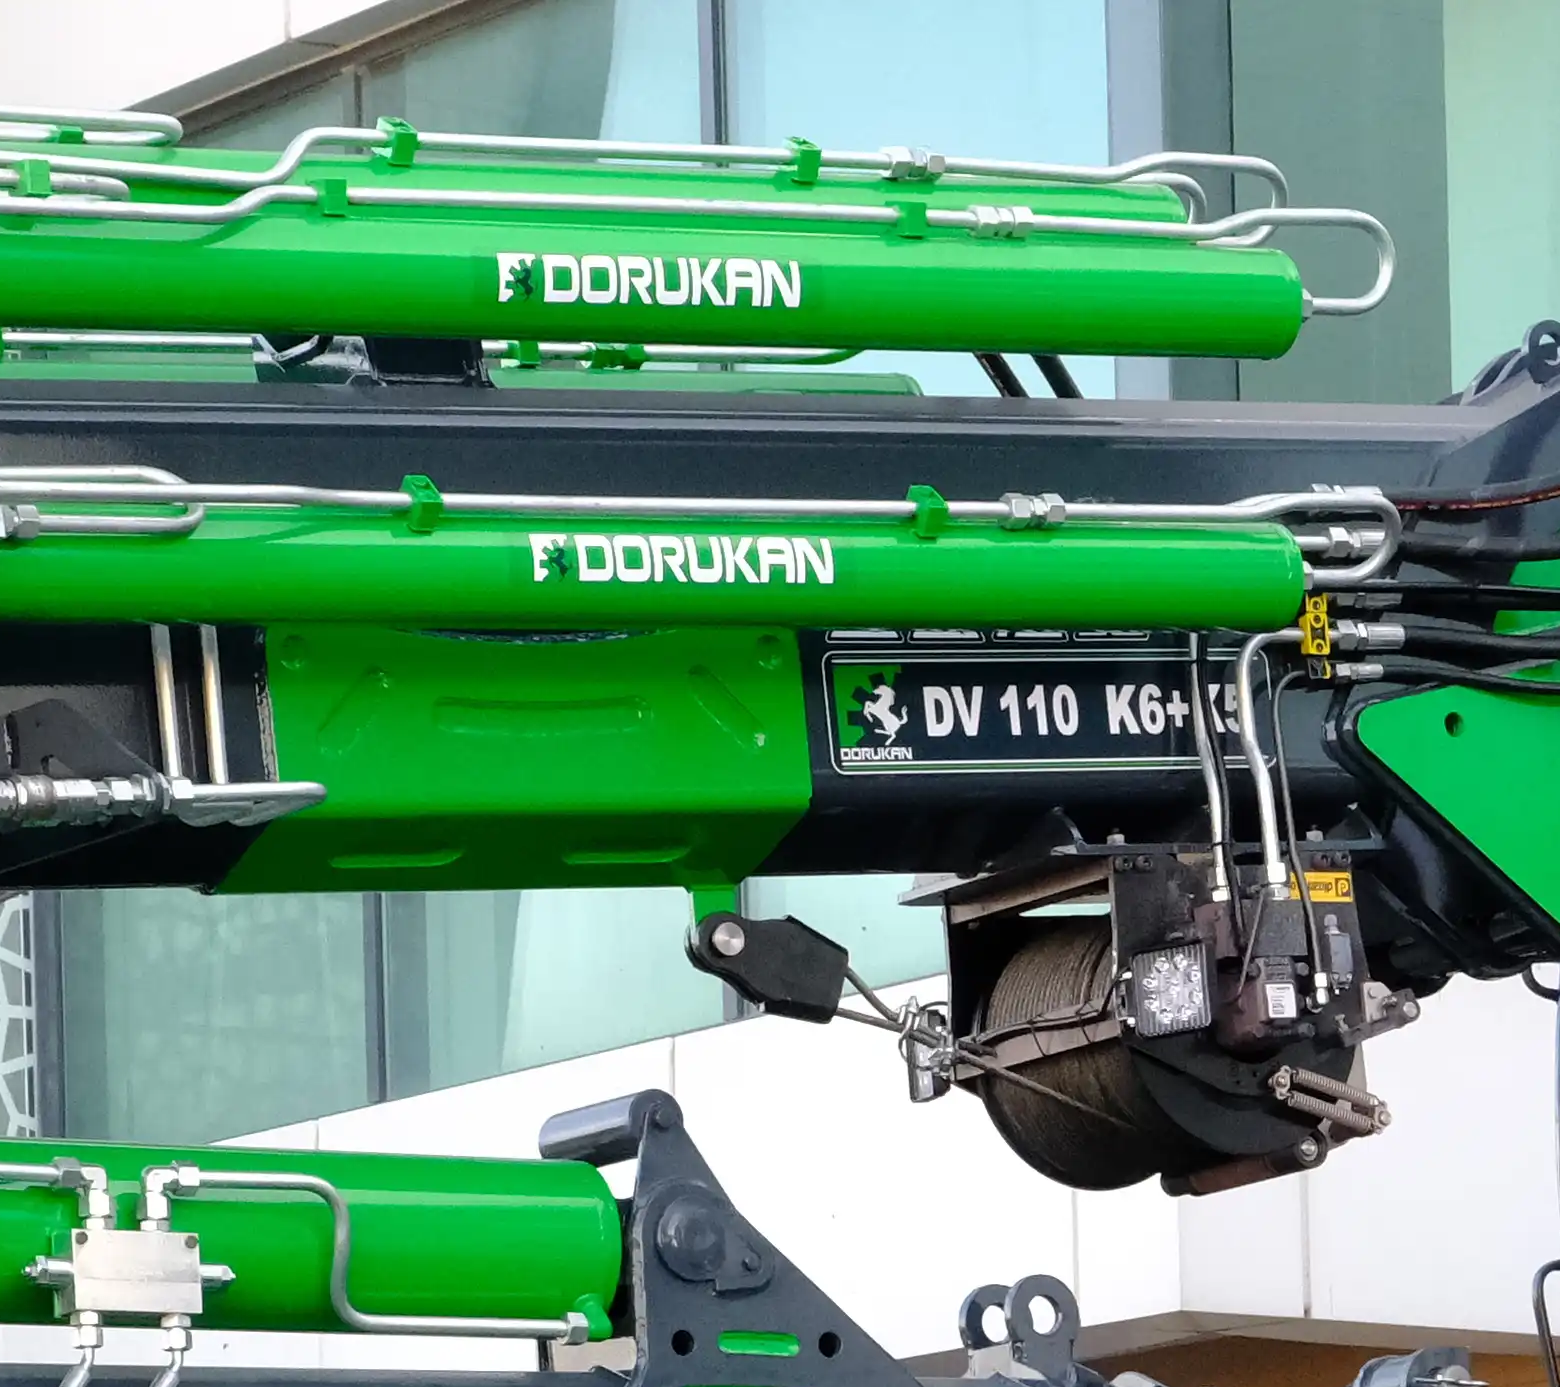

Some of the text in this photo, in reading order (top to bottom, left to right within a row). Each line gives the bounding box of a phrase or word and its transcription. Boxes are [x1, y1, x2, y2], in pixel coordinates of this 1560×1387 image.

[542, 253, 801, 308] DORUKAN
[573, 533, 835, 584] DORUKAN
[922, 685, 983, 738] DV
[999, 683, 1080, 737] 110
[840, 746, 913, 761] DORUKAN
